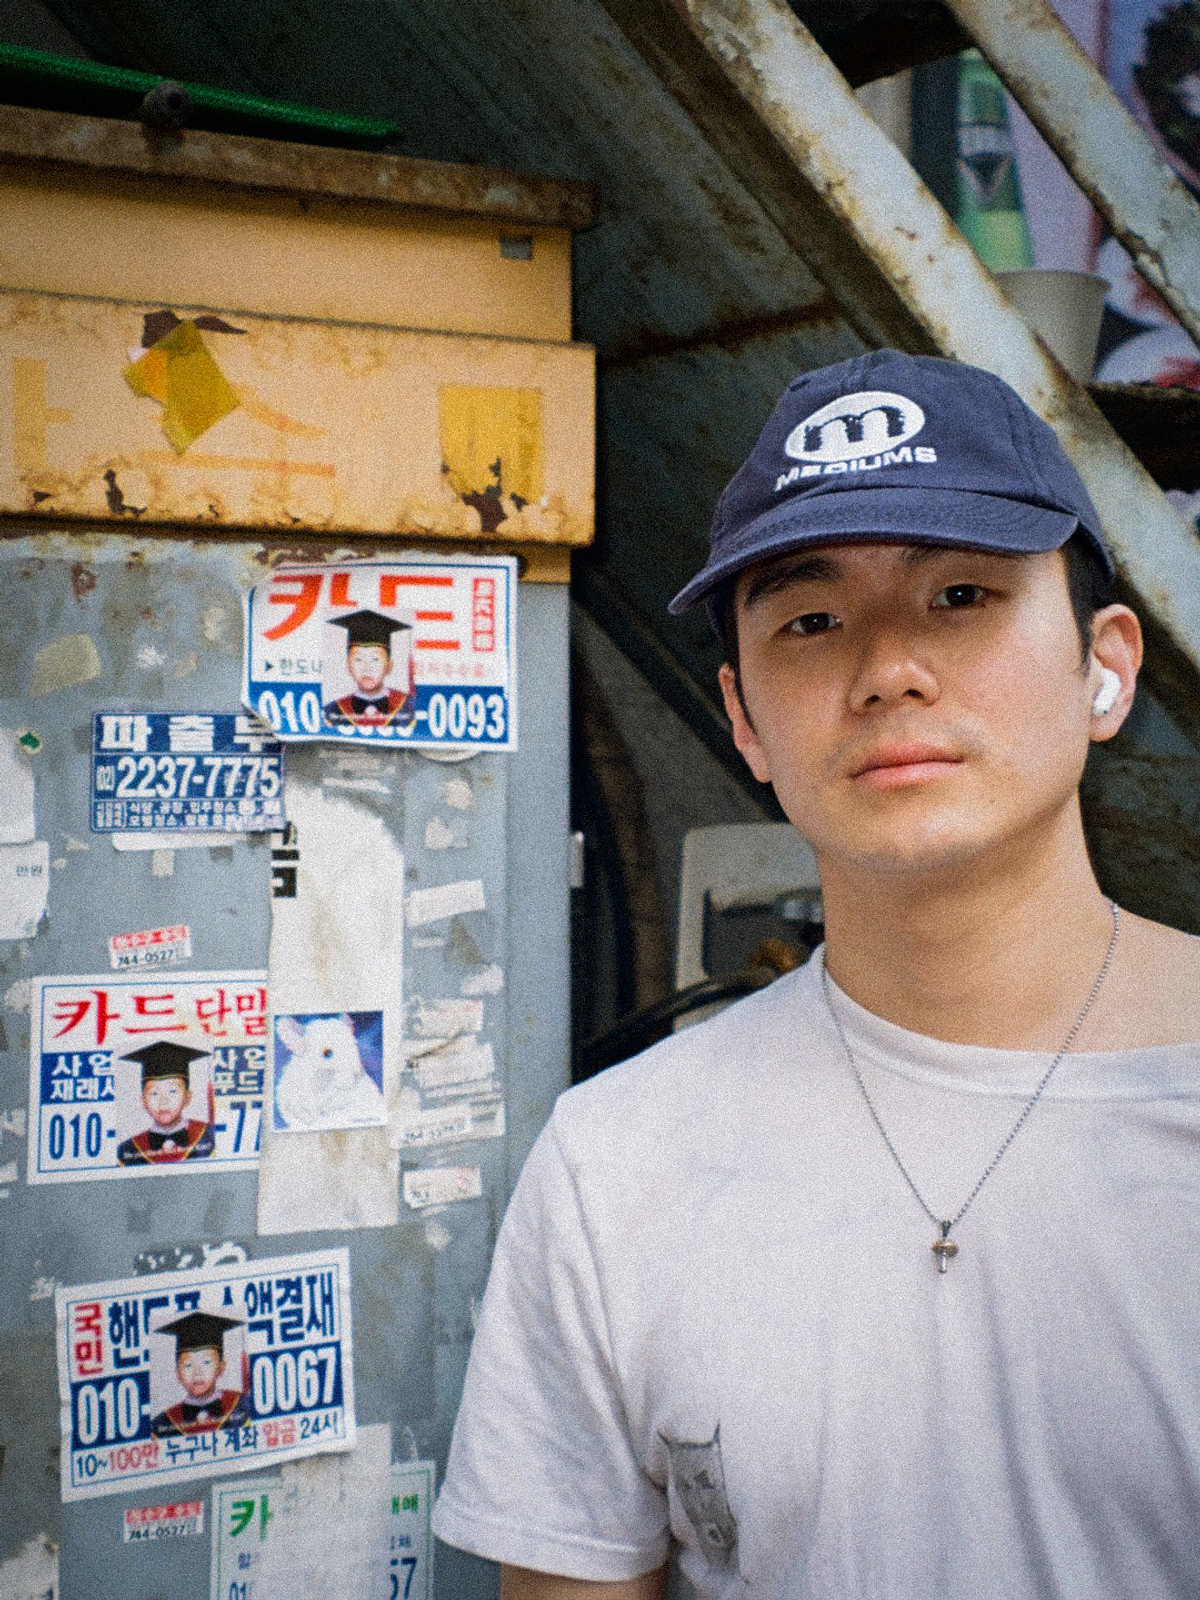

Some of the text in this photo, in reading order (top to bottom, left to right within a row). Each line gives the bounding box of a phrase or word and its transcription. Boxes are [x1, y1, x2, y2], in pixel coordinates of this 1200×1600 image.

[774, 446, 937, 492] MEDIUMS
[53, 989, 188, 1046] 카드
[165, 1429, 220, 1465] 누구나
